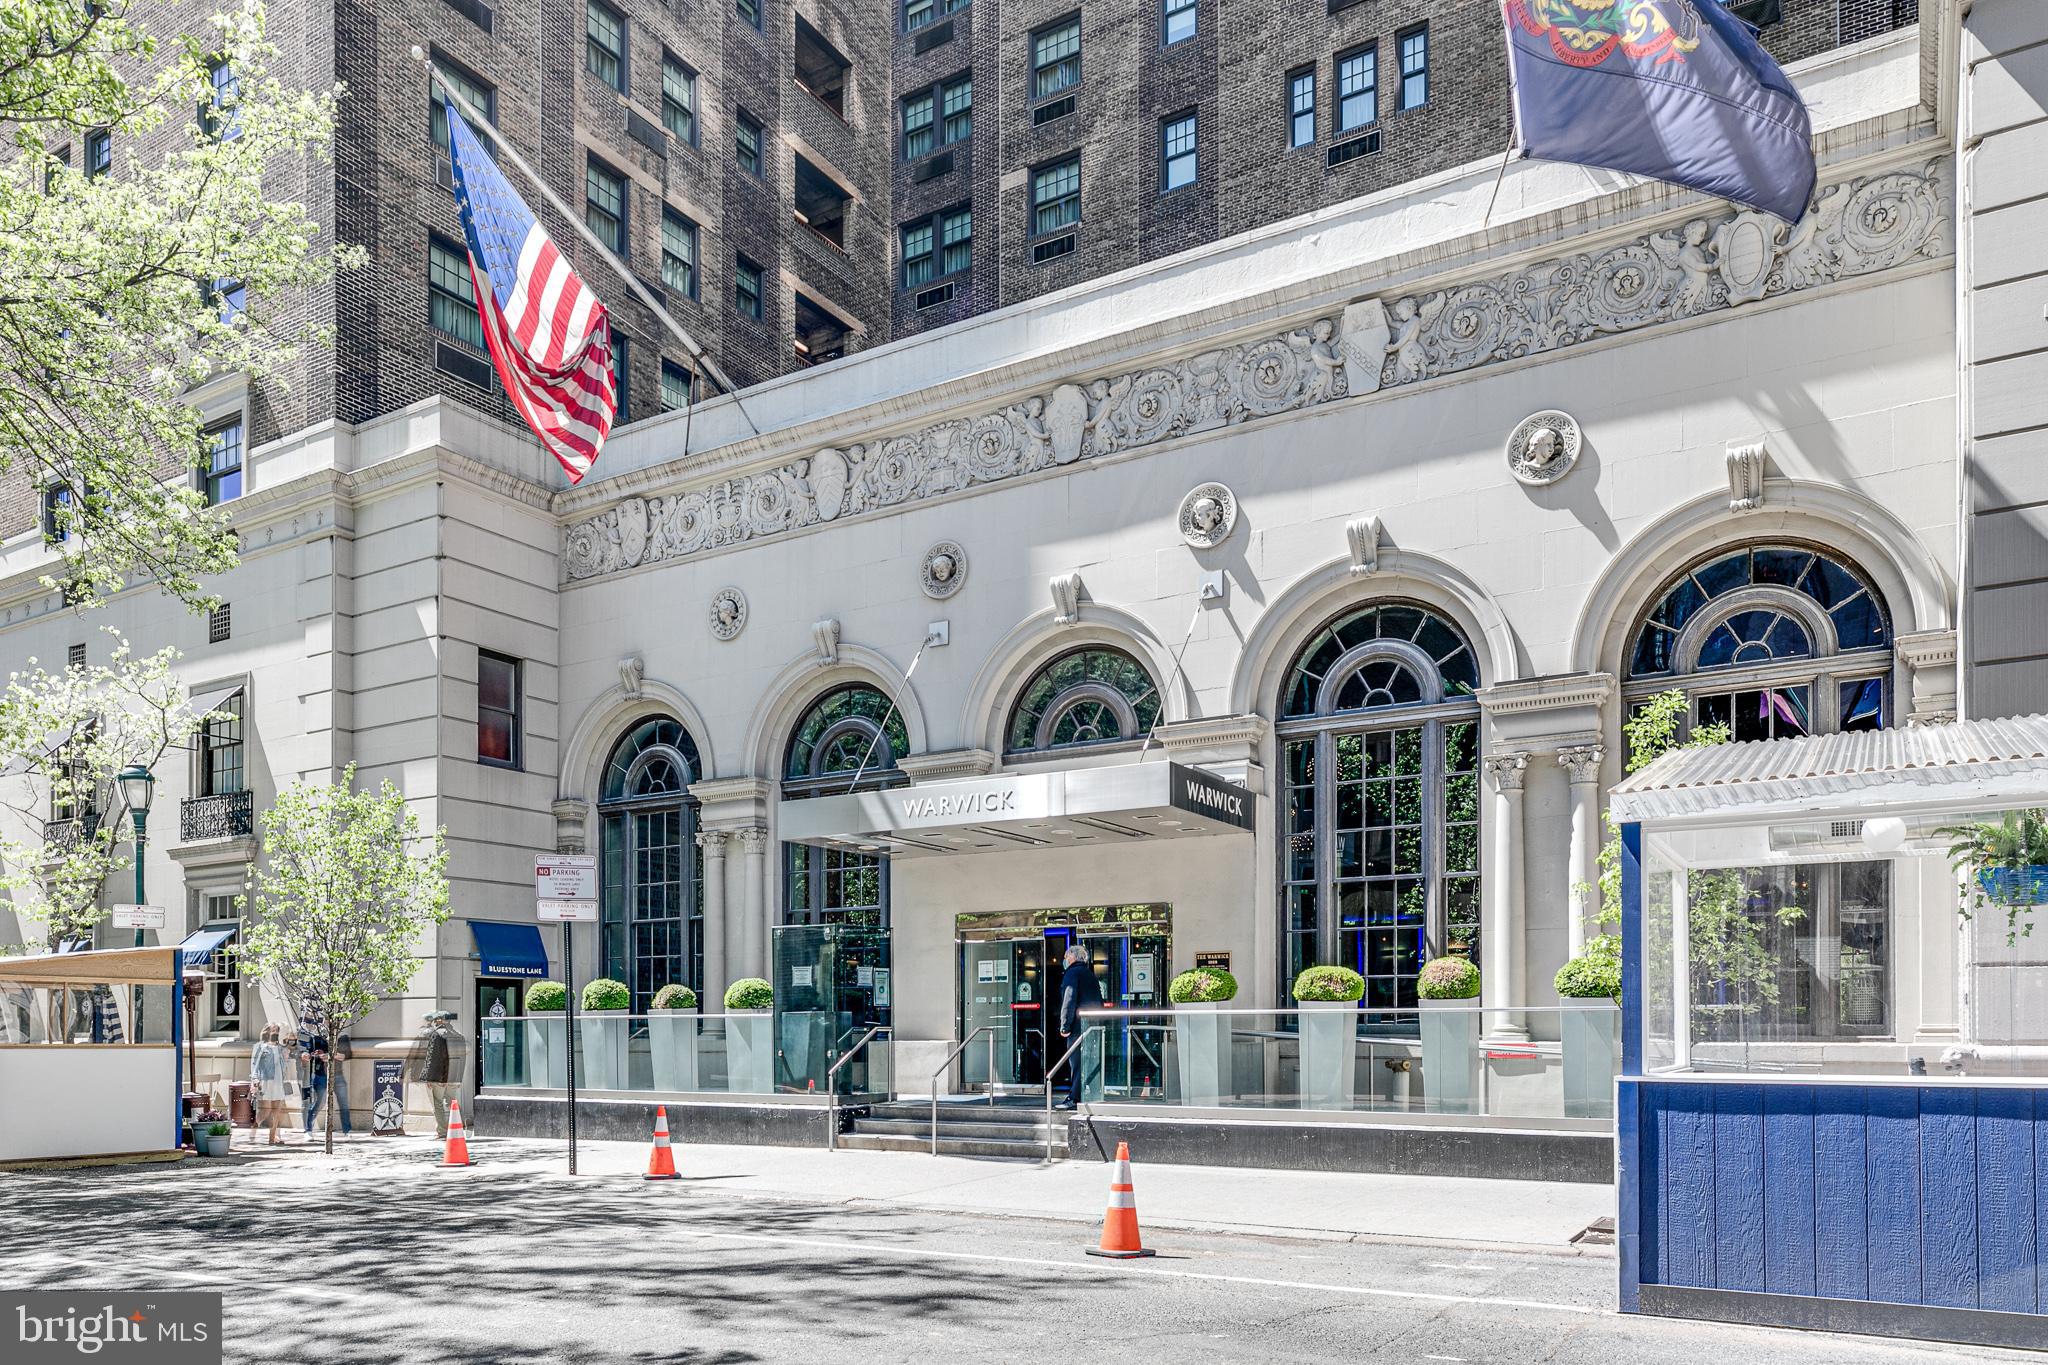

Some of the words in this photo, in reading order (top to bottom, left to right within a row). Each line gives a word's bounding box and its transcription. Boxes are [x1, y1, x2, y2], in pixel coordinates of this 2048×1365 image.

[903, 789, 1015, 818] WARWICK
[1186, 780, 1243, 817] WARWICK
[488, 965, 525, 974] BLUESTONE
[377, 1076, 400, 1084] OPEN
